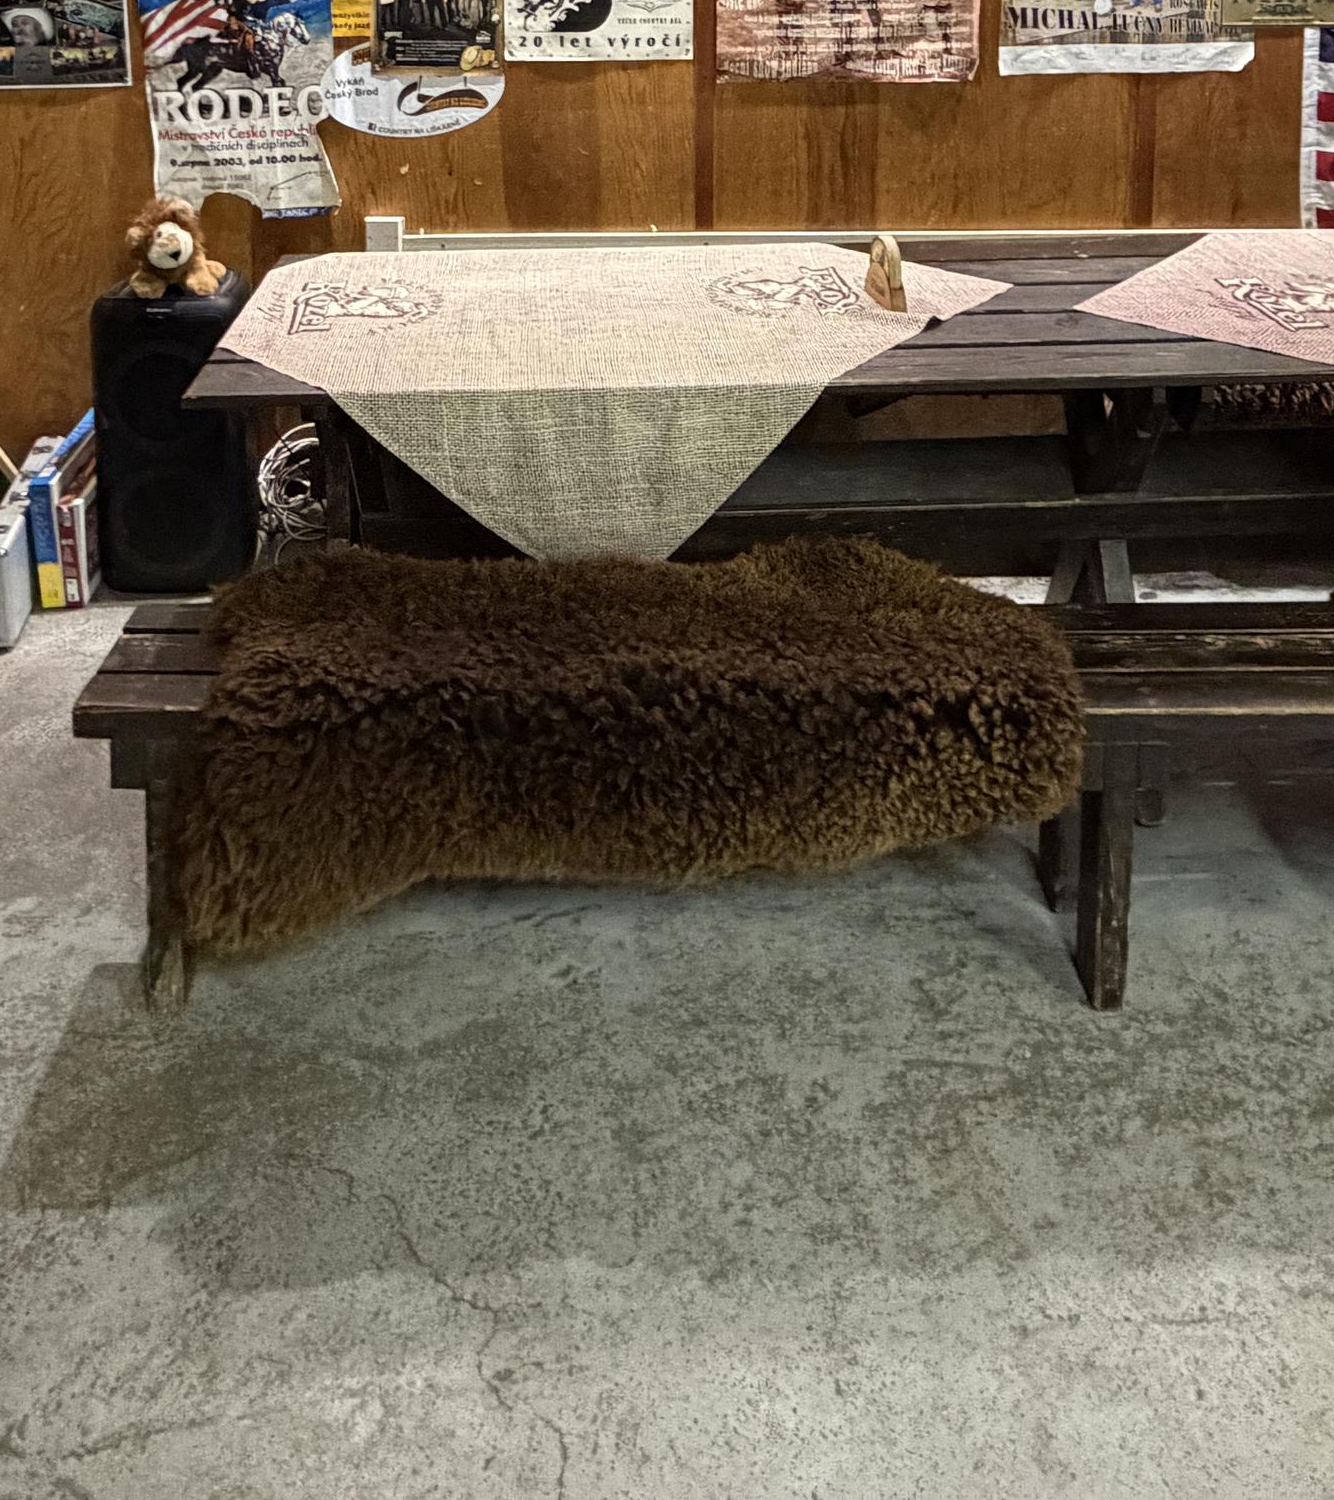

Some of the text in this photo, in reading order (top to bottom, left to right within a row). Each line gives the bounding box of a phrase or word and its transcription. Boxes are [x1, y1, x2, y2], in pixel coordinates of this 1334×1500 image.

[1007, 6, 1108, 32] MICHAL
[517, 33, 682, 50] 20 let výročí
[324, 85, 380, 101] Český Brod
[151, 84, 329, 124] RODEO
[158, 128, 226, 142] Mistrovství
